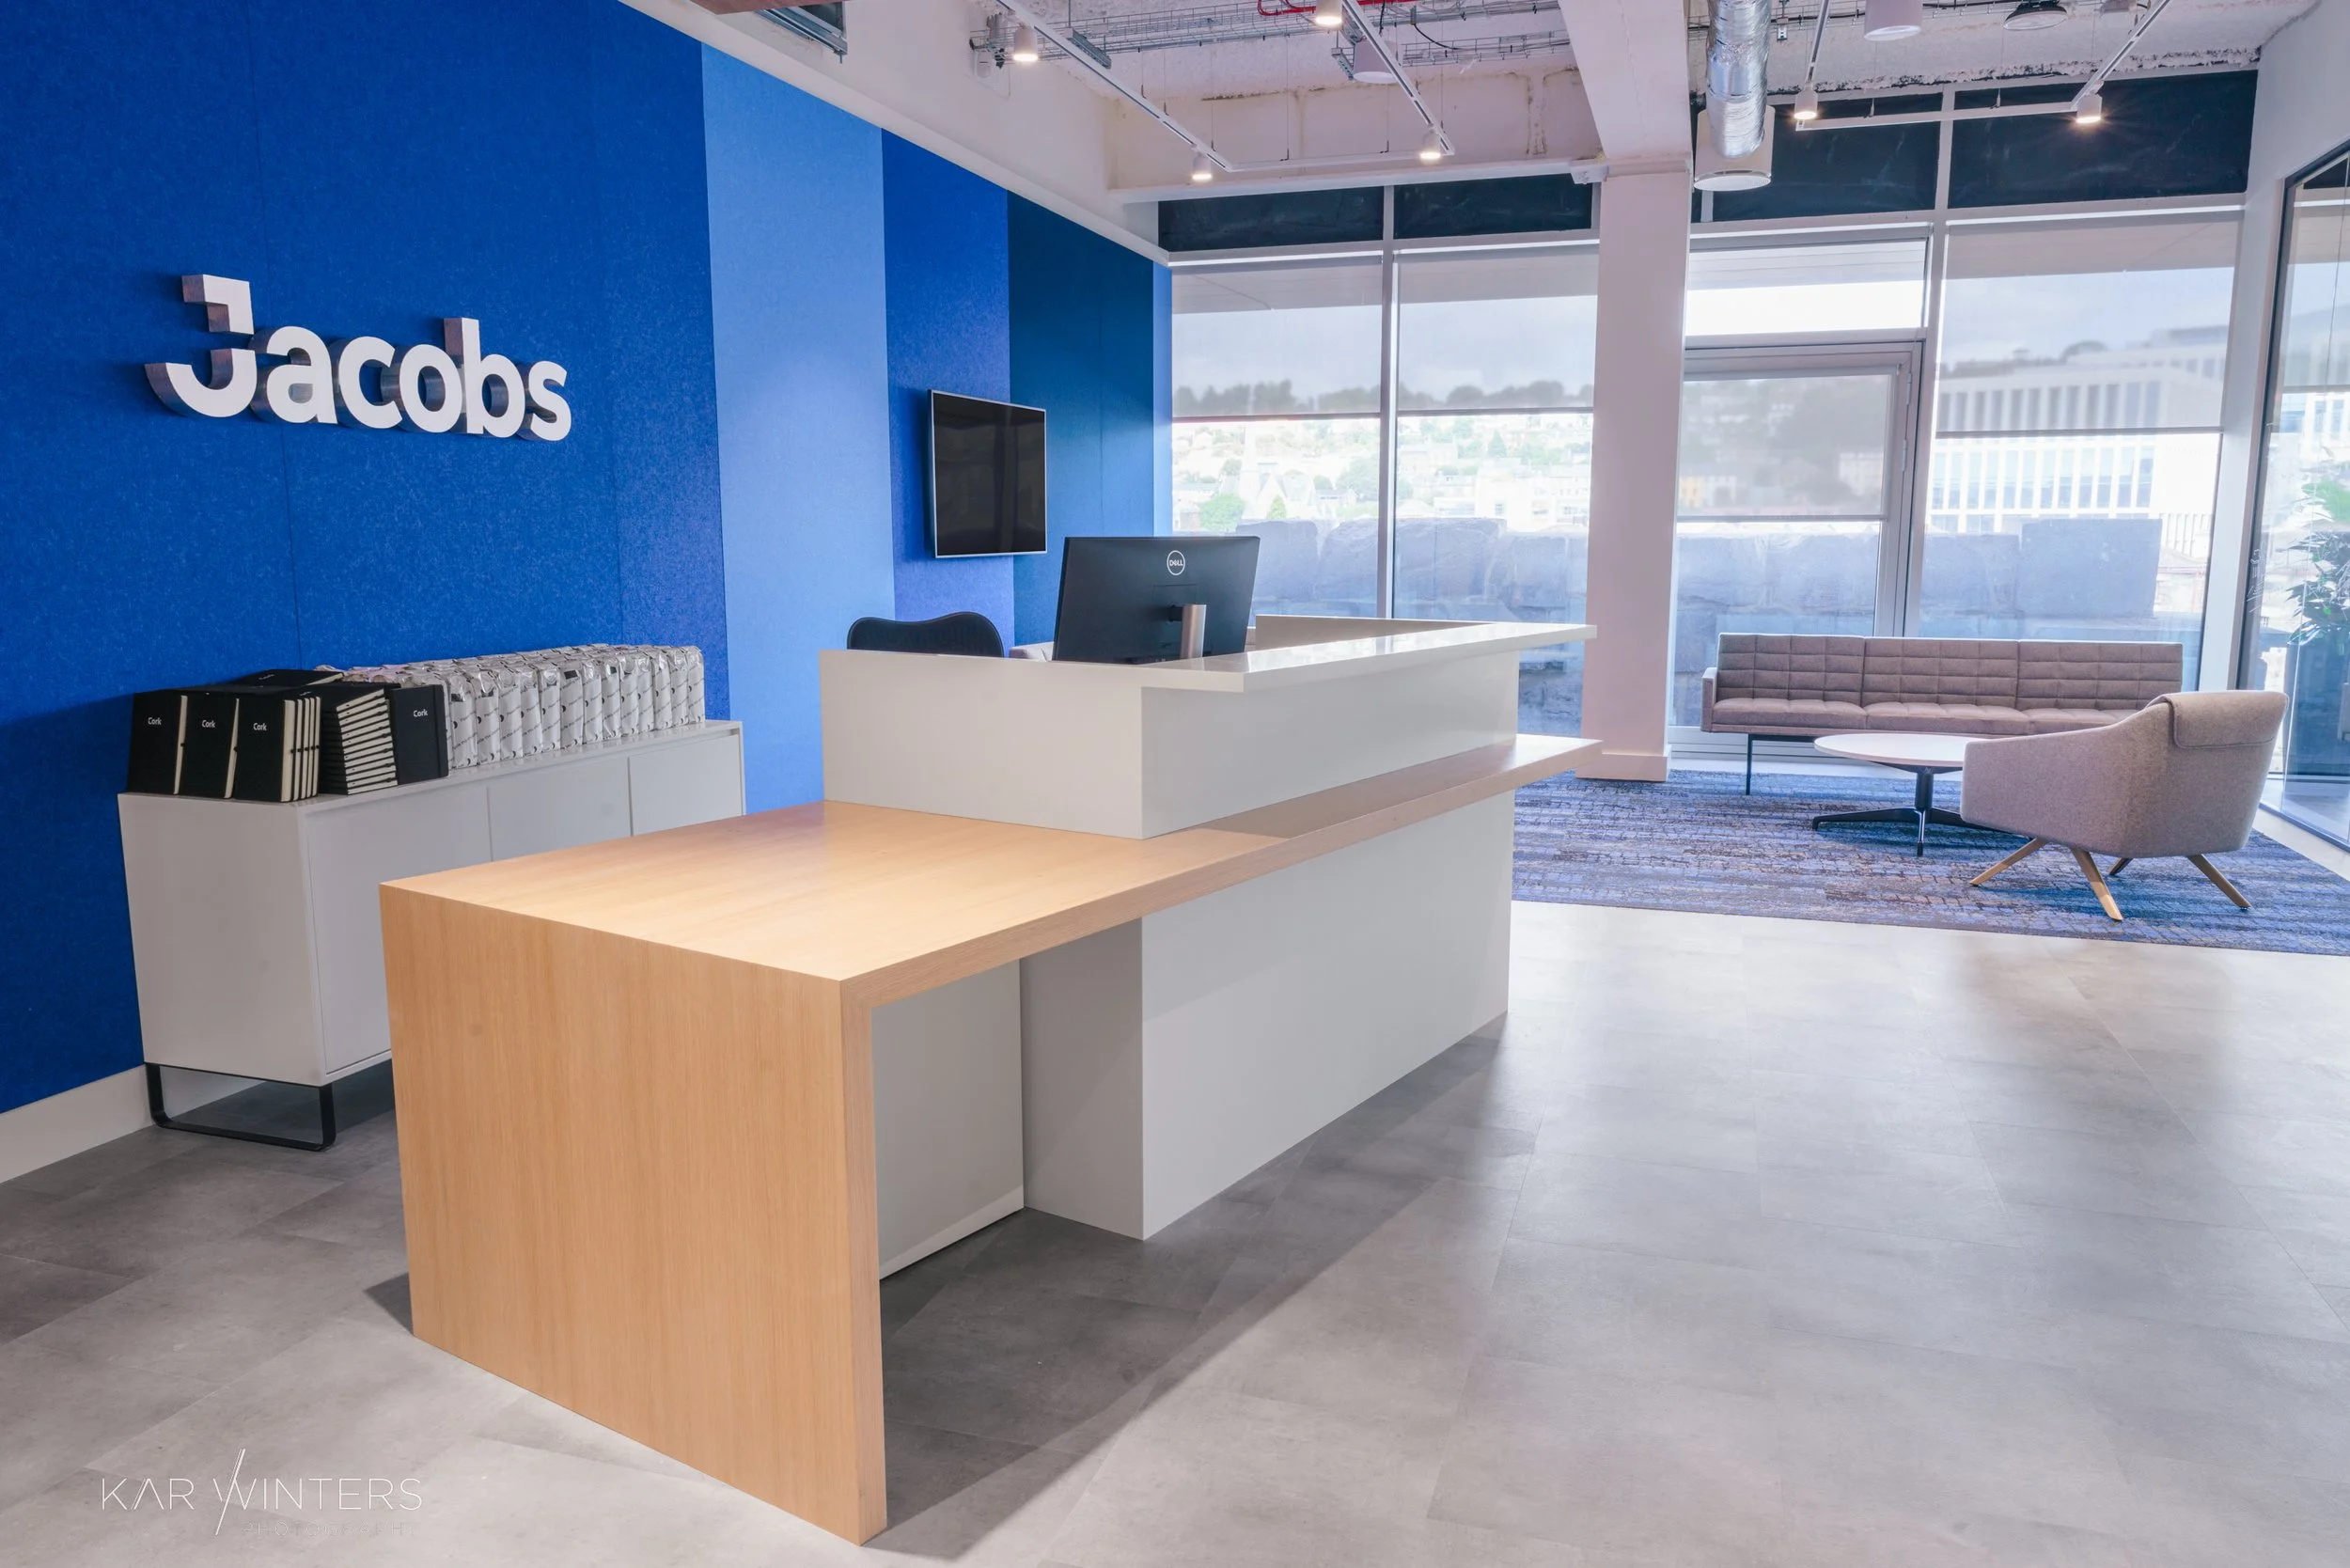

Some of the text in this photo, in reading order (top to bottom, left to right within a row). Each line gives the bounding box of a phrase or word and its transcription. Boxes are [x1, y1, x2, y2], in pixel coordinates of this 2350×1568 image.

[146, 273, 572, 442] Jacobs
[413, 709, 428, 717] Cork
[202, 719, 215, 728] Cork
[253, 722, 267, 730] Cork
